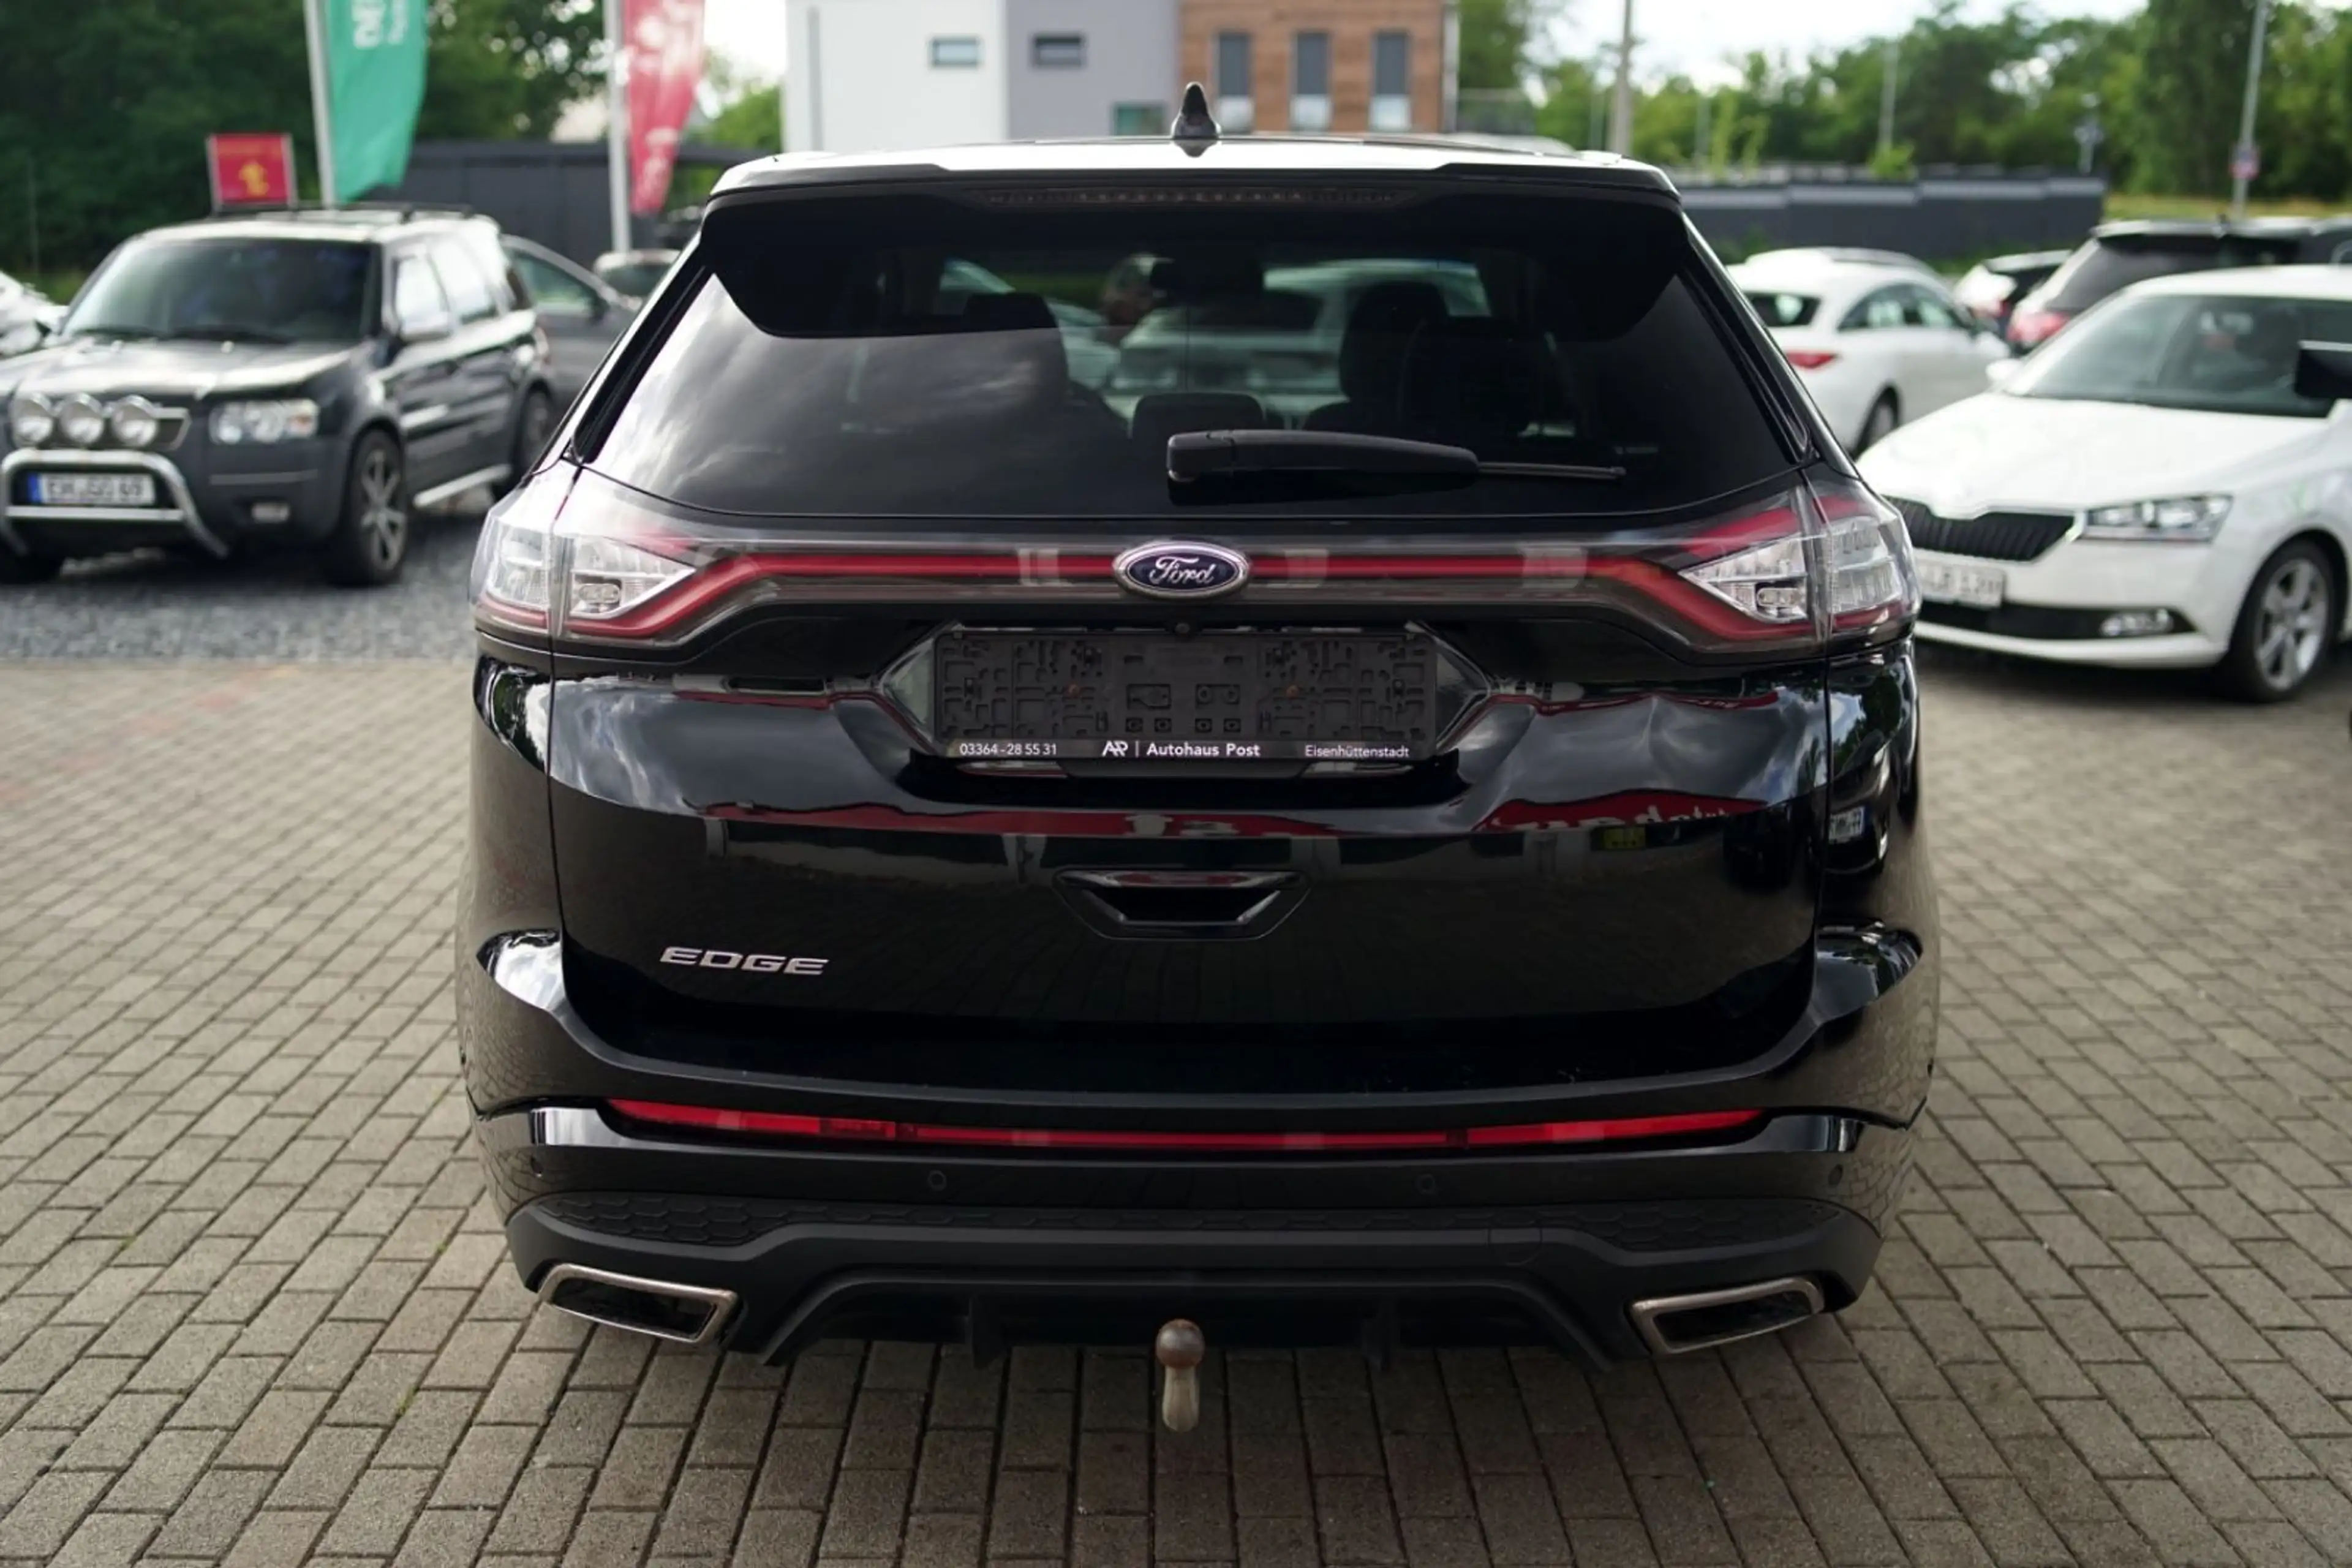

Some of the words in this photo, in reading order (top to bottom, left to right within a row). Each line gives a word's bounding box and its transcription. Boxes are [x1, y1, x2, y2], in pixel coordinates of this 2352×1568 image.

[1149, 555, 1215, 584] Ford
[1025, 743, 1041, 756] 55
[1042, 743, 1057, 755] 31
[1146, 741, 1220, 757] Autohaus
[1226, 742, 1261, 757] Post
[1305, 744, 1409, 758] Eisenhüttenstadt
[659, 946, 830, 975] EDGE
